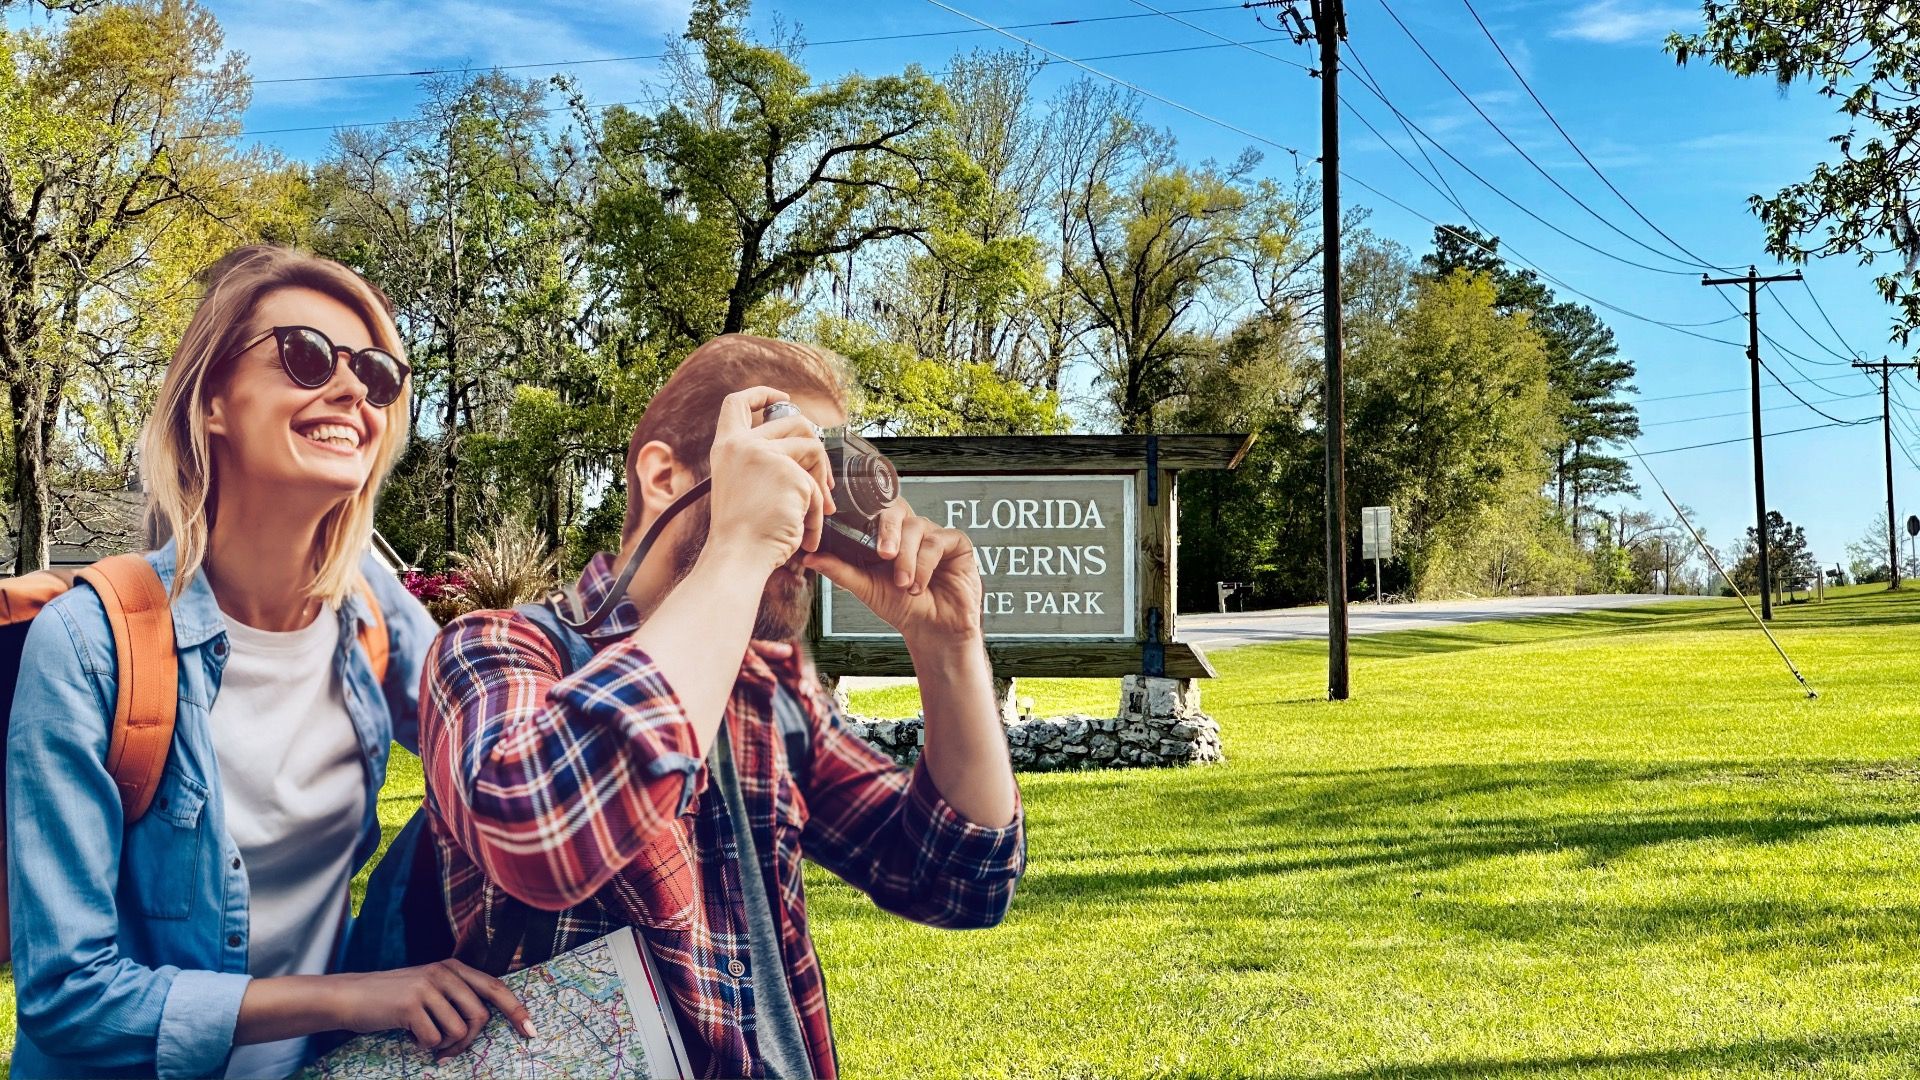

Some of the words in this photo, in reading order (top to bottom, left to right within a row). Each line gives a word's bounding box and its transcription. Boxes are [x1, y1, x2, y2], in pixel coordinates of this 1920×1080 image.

[944, 499, 1106, 529] FLORIDA
[972, 545, 1107, 576] AVERNS
[1024, 591, 1105, 615] PARK
